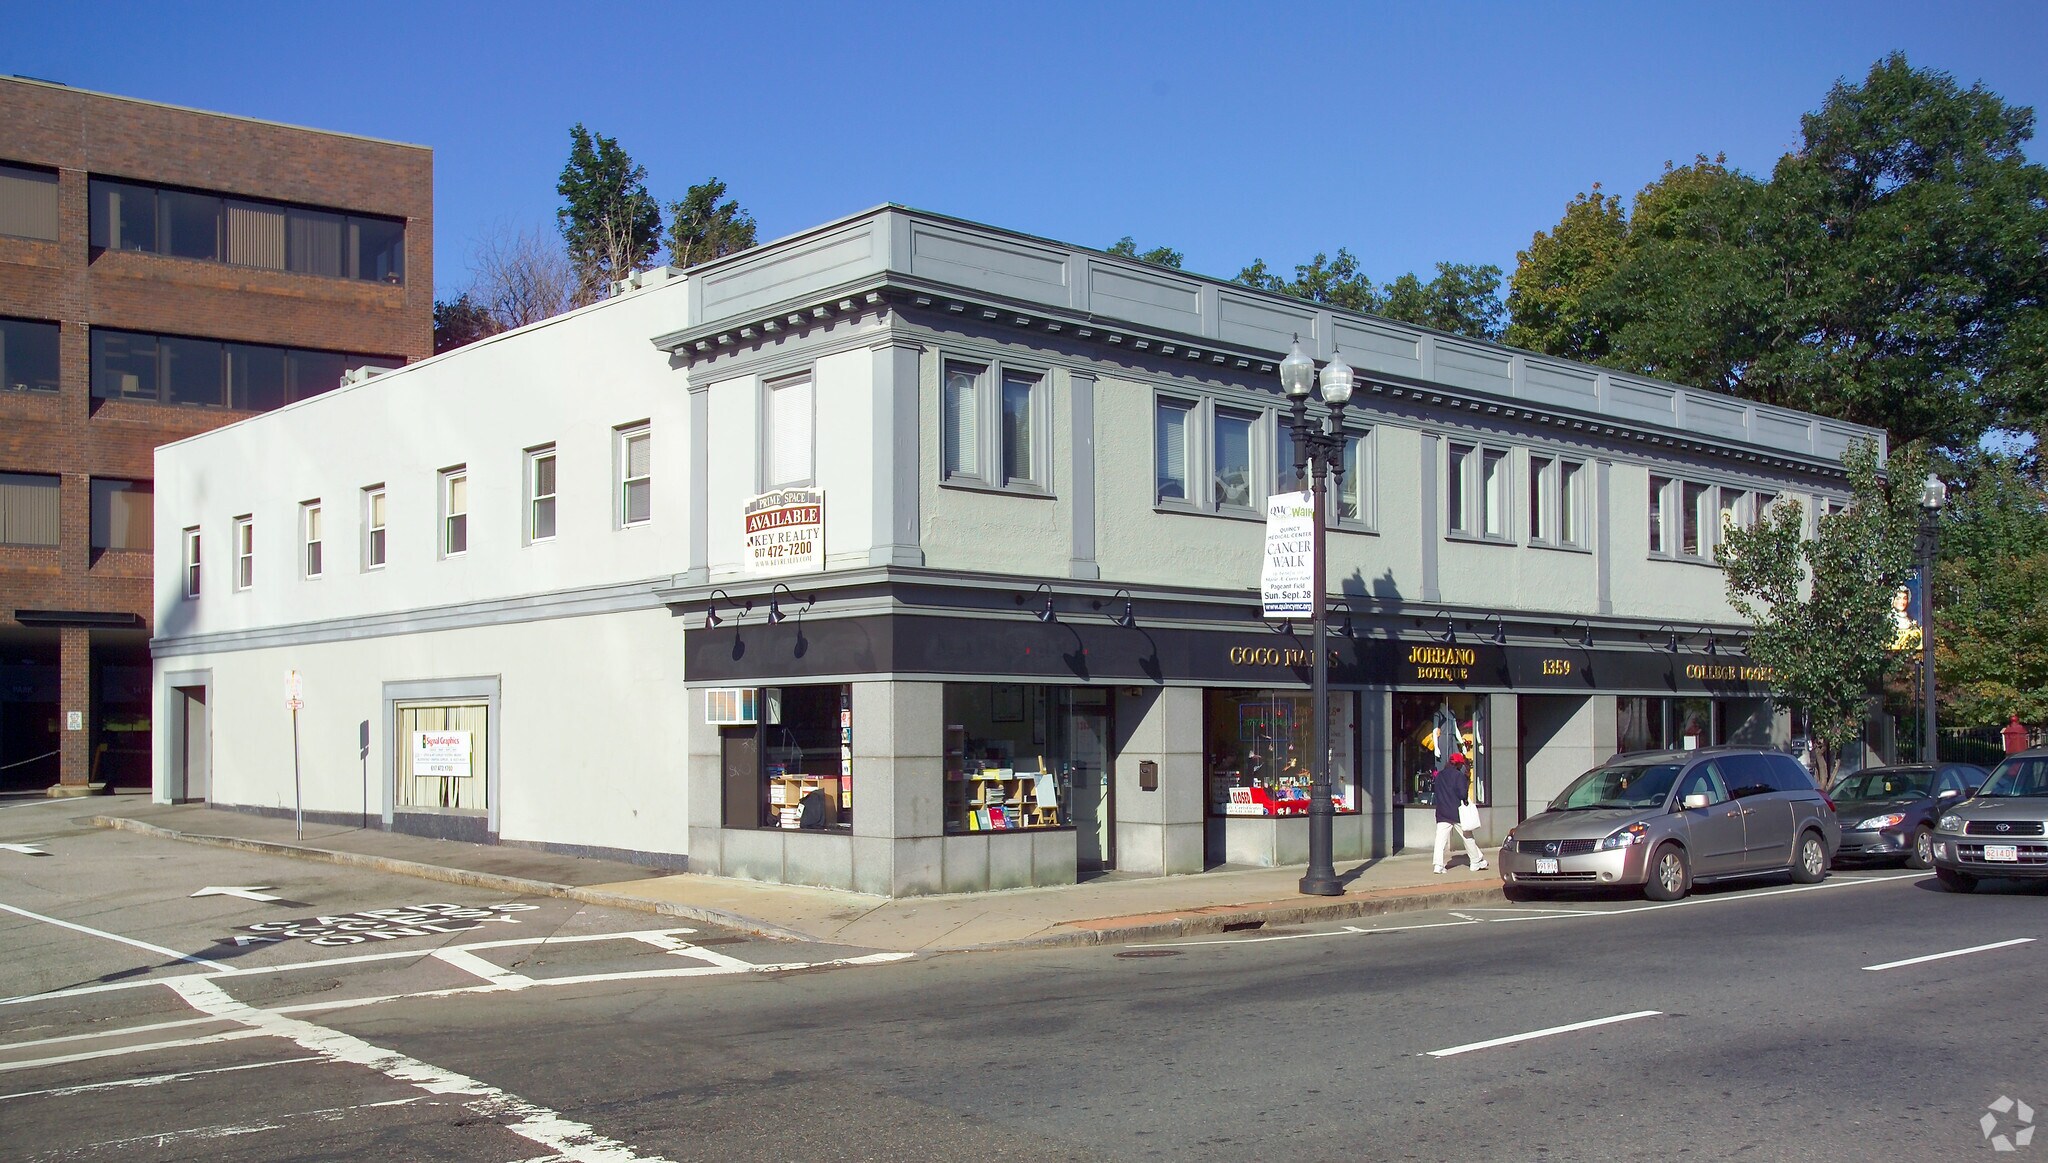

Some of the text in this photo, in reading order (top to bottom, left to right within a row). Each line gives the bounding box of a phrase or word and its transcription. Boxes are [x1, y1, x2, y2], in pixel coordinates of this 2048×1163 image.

[760, 492, 806, 509] PRIME SPACE
[749, 508, 818, 532] AVAILABLE
[755, 527, 820, 547] KEY REALTY
[1280, 526, 1301, 534] QUINCY
[755, 541, 812, 558] 617 472-7200
[1267, 540, 1311, 556] CANCER
[1273, 555, 1305, 568] WALK
[1264, 590, 1311, 600] Sun. Sept. 28
[1265, 603, 1311, 611] www.quincymc.org
[1408, 646, 1476, 666] JORBANO
[1418, 666, 1468, 682] BOTIQUE
[1542, 659, 1571, 676] 1359
[1686, 664, 1736, 680] COLLEGE
[427, 736, 459, 747] Signal Graphics
[1232, 791, 1251, 804] CLOSED
[234, 903, 541, 947] ACCESS
[249, 903, 462, 932] CARD
[310, 914, 522, 947] ONLY
